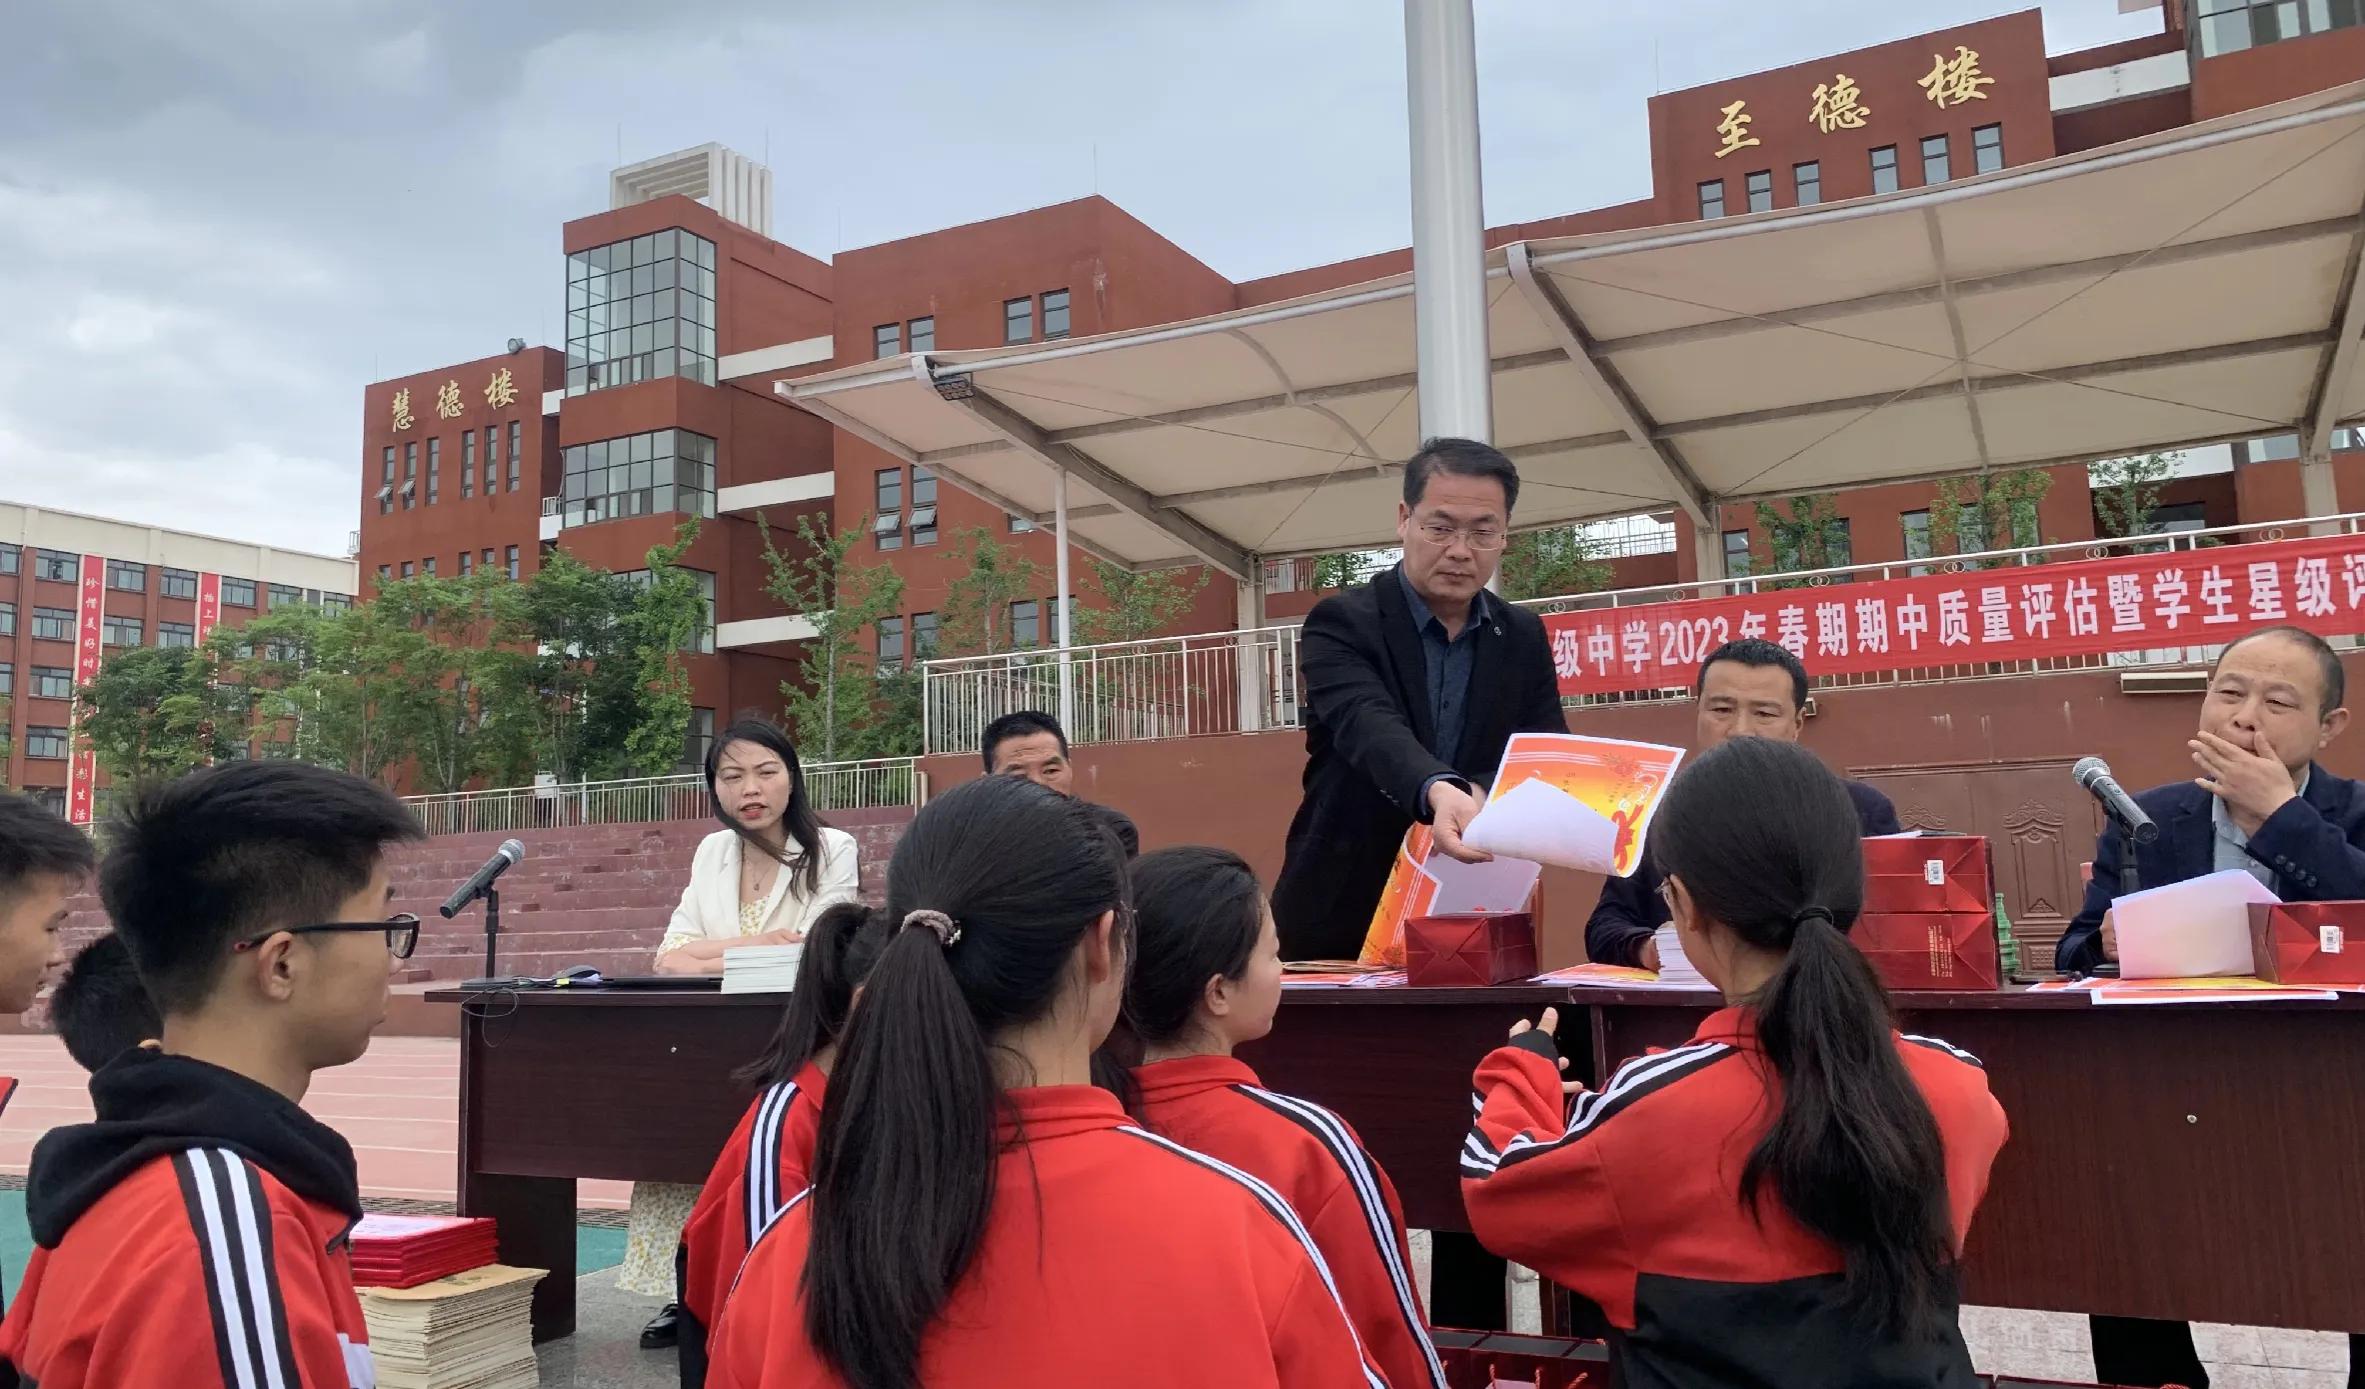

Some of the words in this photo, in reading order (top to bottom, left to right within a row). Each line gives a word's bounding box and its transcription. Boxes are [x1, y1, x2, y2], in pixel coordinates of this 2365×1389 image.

[1715, 46, 1995, 158] 至德楼
[392, 368, 519, 432] 慧德楼
